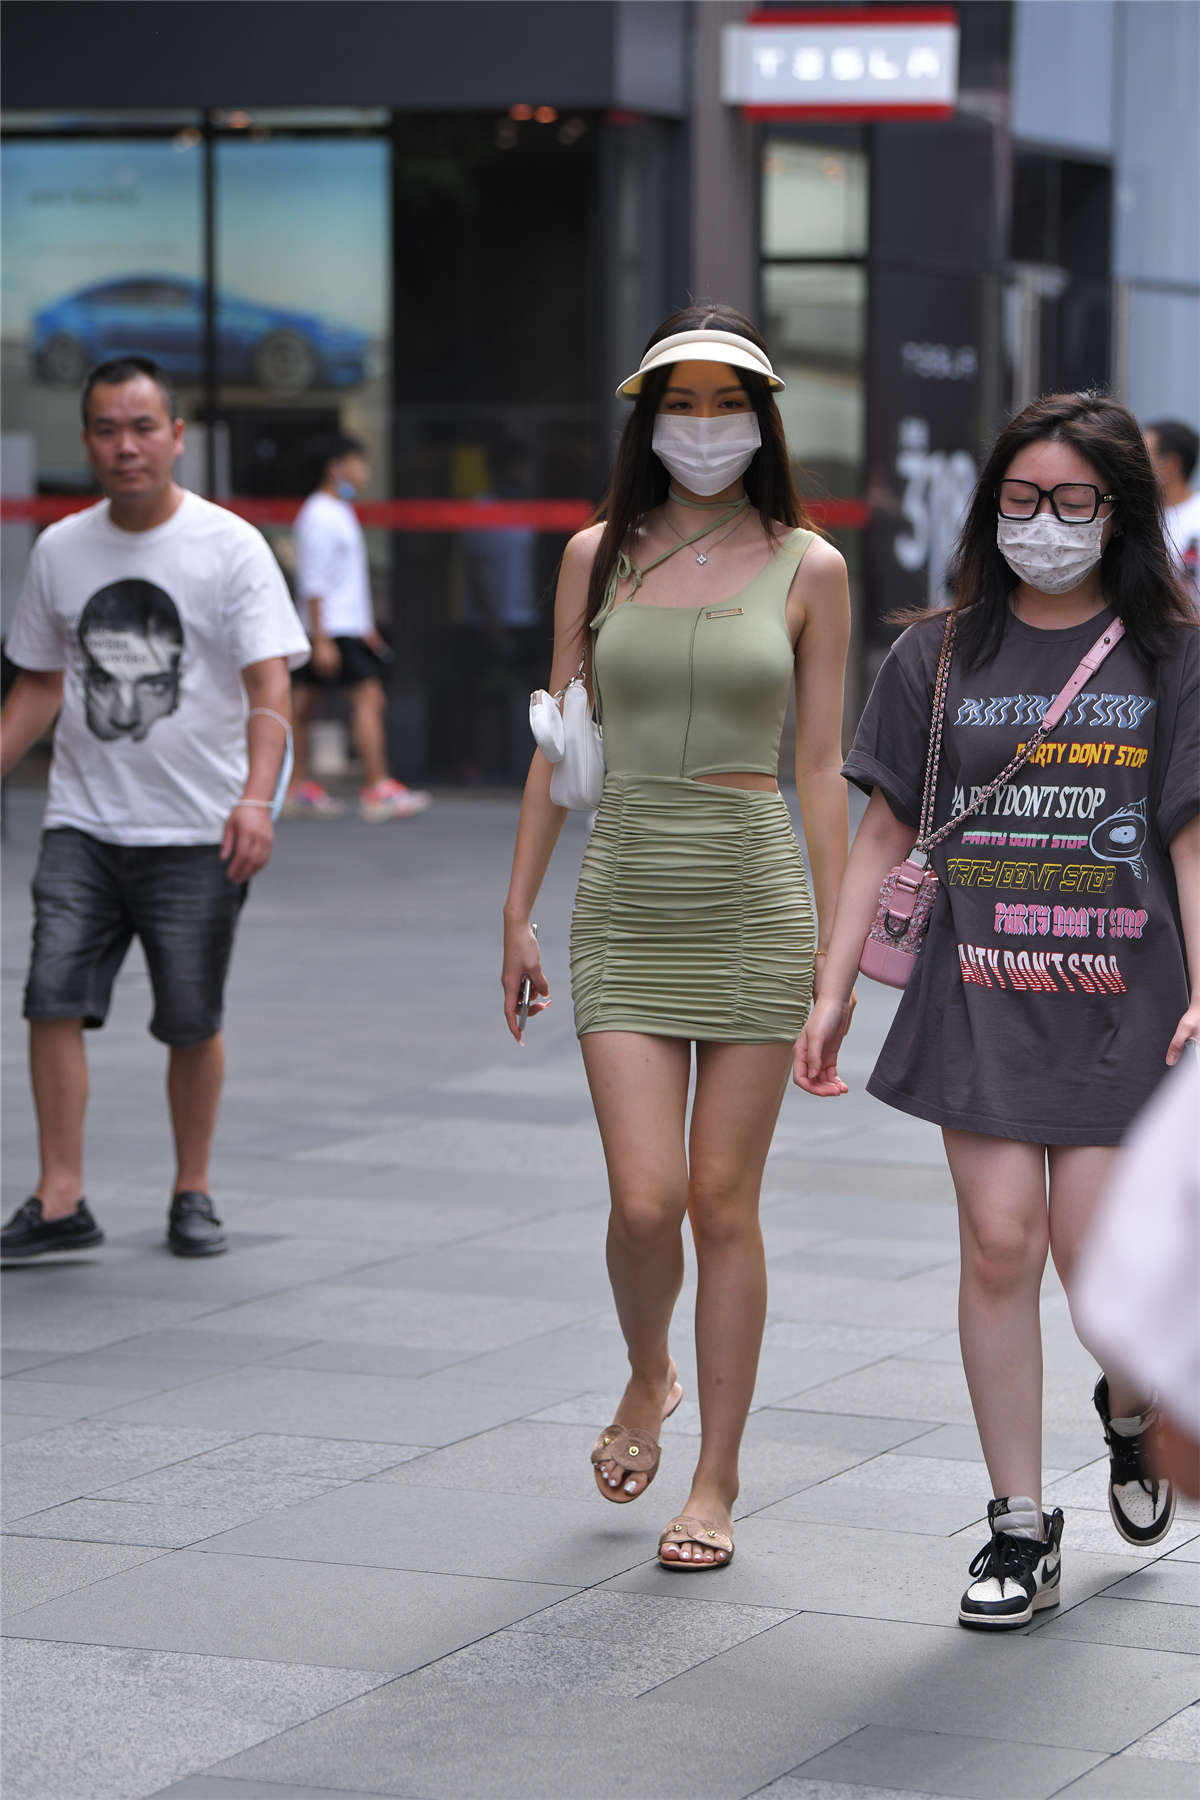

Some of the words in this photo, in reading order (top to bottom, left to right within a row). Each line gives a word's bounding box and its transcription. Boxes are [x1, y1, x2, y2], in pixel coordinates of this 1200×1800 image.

[753, 46, 941, 81] TESLA
[1115, 745, 1148, 768] STOP
[1051, 834, 1089, 849] STOP
[994, 902, 1052, 936] PARTY
[1109, 907, 1148, 939] STOP
